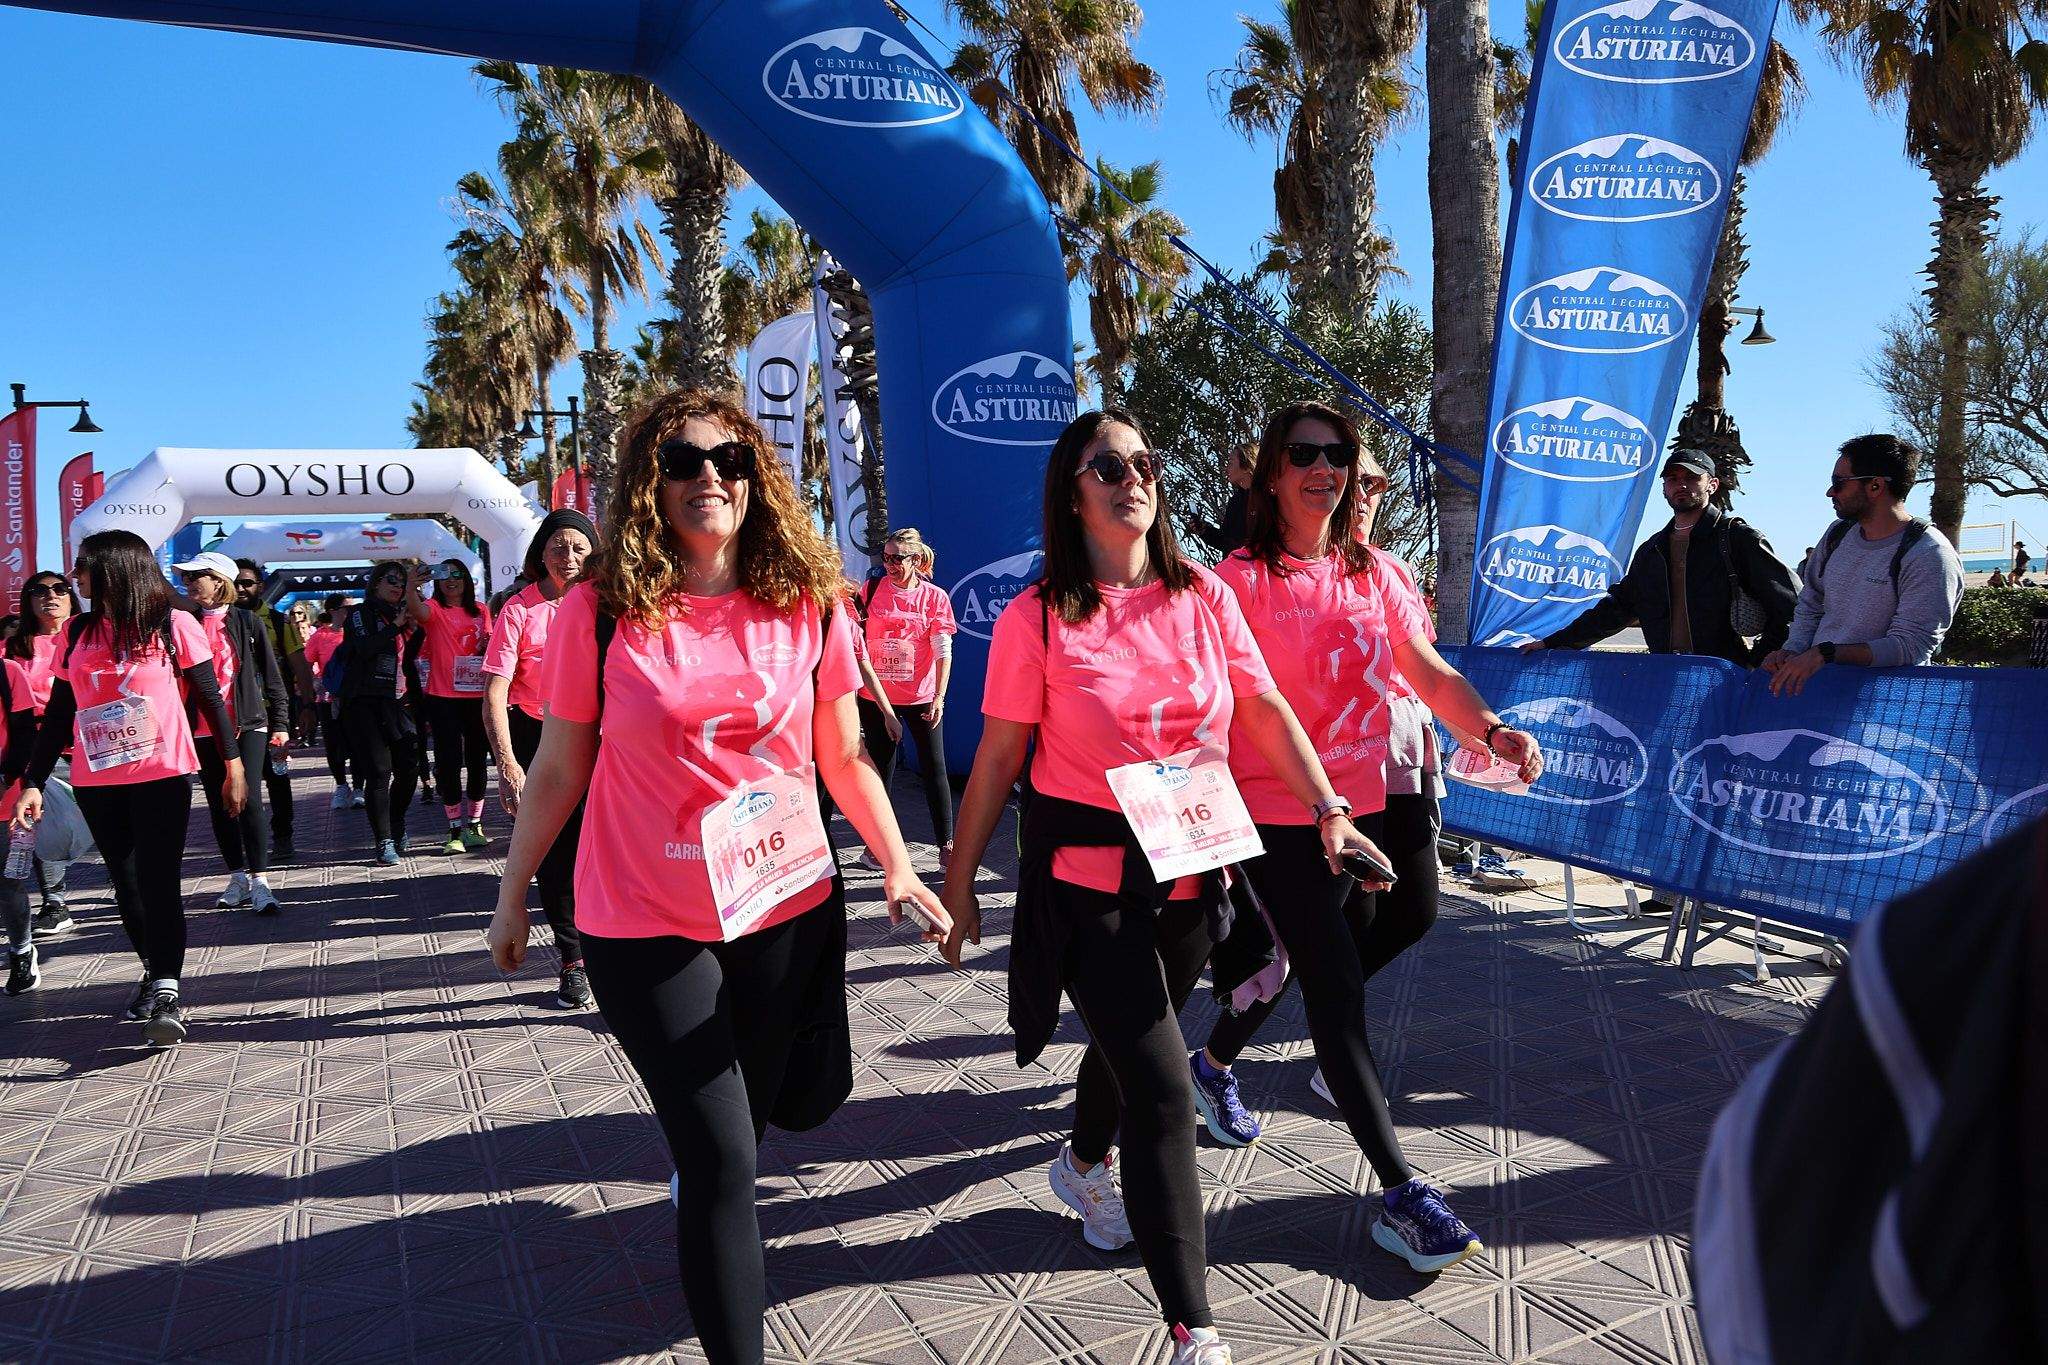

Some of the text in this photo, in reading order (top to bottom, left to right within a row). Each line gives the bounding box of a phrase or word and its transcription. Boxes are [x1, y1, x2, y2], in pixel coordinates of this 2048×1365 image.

[1601, 24, 1736, 41] CENTRAL LECHERA
[1566, 26, 1736, 67] ASTURIANA
[815, 57, 883, 71] CENTRAL
[781, 59, 957, 109] ASTURIANA
[1574, 163, 1702, 176] CENTRAL LECHERA
[1541, 166, 1703, 203] ASTURIANA
[1552, 296, 1670, 309] CENTRAL LECHERA
[1520, 296, 1672, 336] ASTURIANA
[975, 384, 1035, 394] CENTRAL
[1531, 422, 1642, 442] CENTRAL LECHERA
[1502, 422, 1643, 467] ASTURIANA
[5, 440, 23, 544] Santander
[225, 463, 415, 498] OYSHO
[103, 503, 166, 516] OYSHO
[468, 498, 519, 510] OYSHO
[1484, 547, 1610, 591] ASTURIANA
[1511, 546, 1608, 569] CENTRAL LECHERA
[989, 583, 1031, 594] CENT
[637, 654, 702, 668] OYSHO
[108, 726, 138, 742] 016
[1541, 747, 1629, 788] RIANA
[1723, 761, 1803, 785] CENTRAL
[1683, 759, 1914, 841] ASTURIANA
[665, 842, 705, 860] CARR
[743, 831, 785, 868] 016
[756, 860, 776, 878] 1635
[784, 867, 820, 890] Santander
